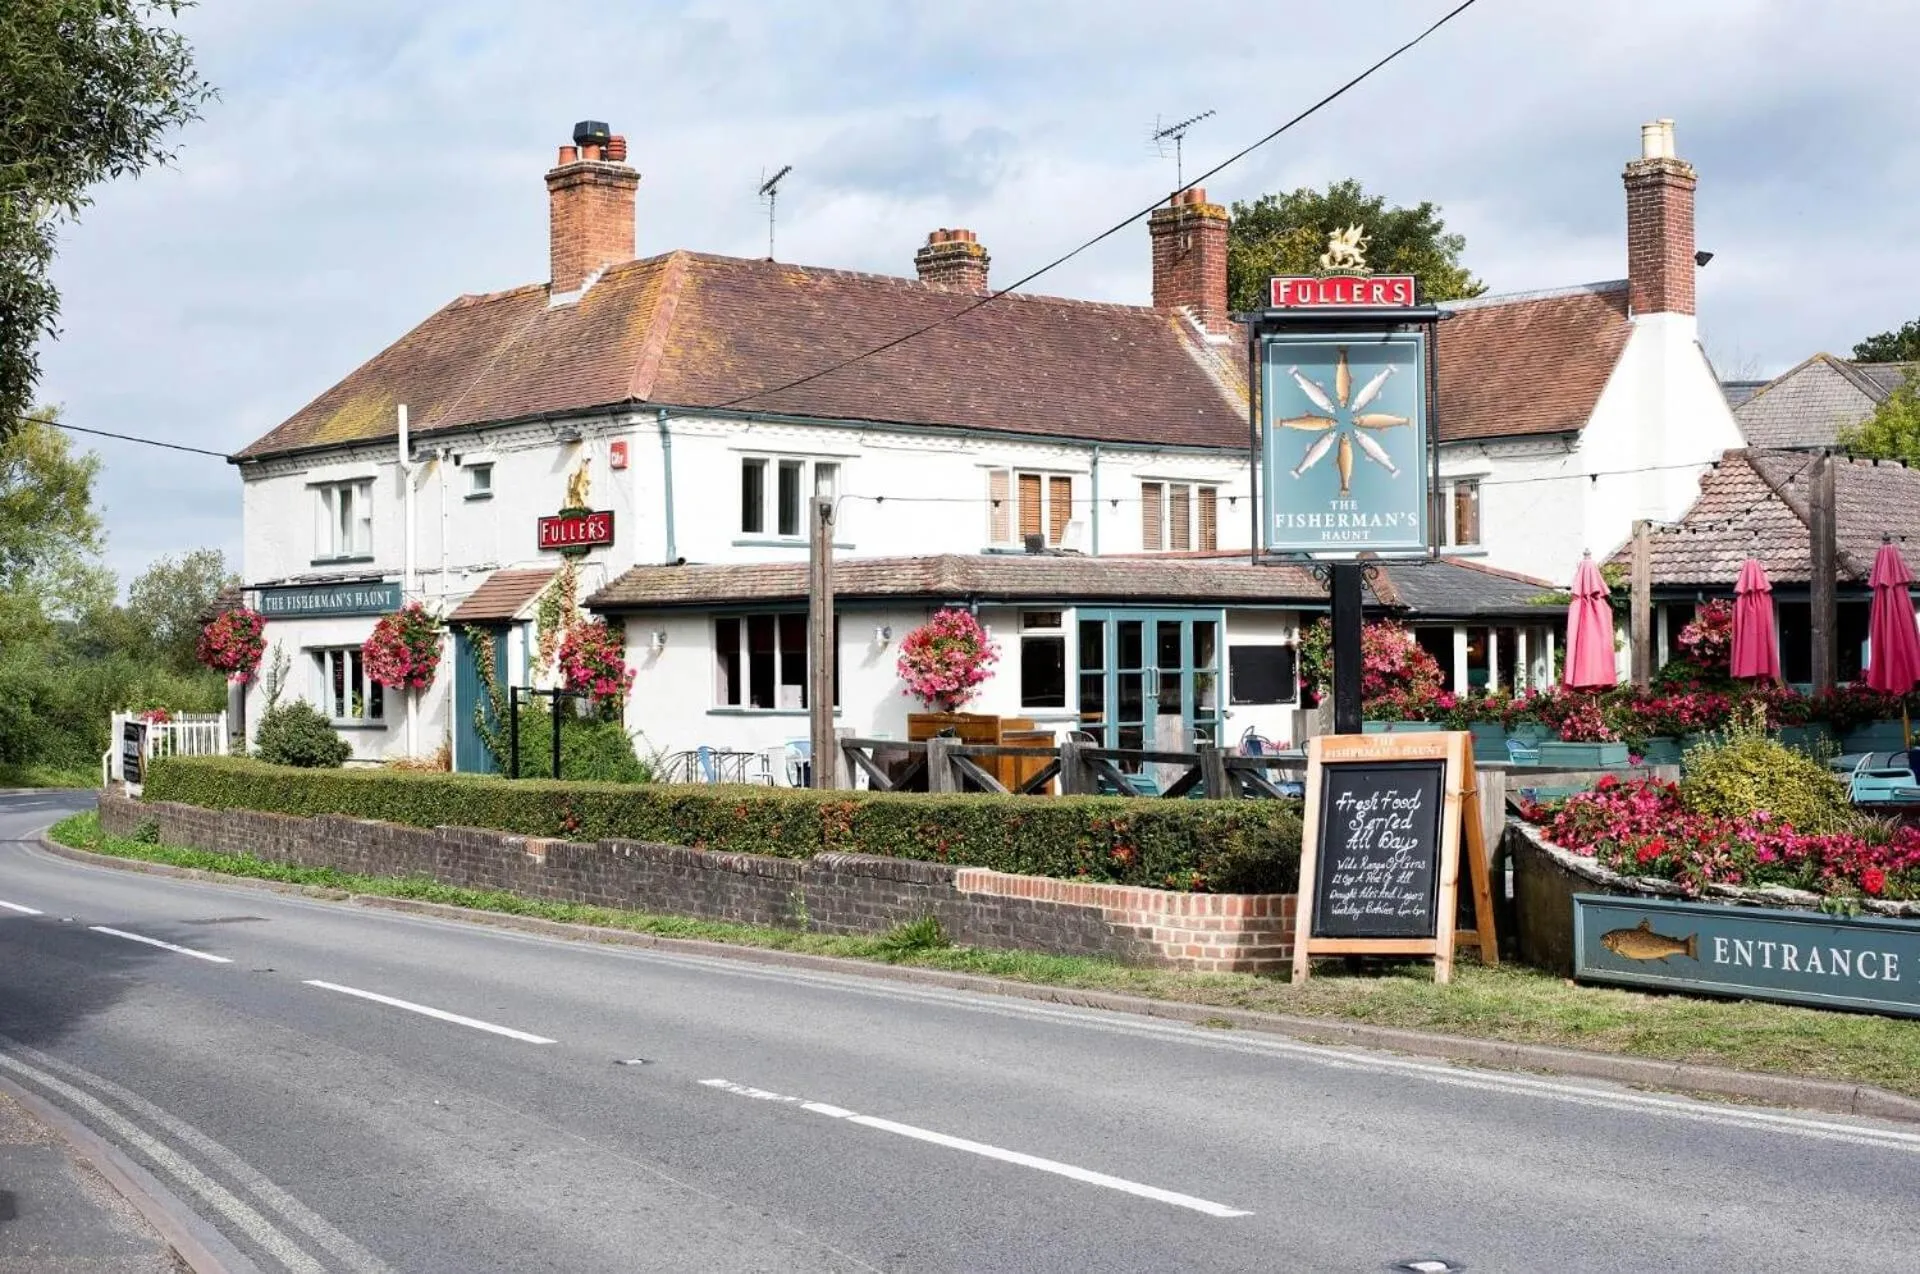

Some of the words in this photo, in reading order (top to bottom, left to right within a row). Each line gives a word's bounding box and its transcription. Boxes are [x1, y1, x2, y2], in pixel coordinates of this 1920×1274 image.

[1279, 280, 1406, 305] FULLER'S
[1330, 500, 1358, 511] THE
[542, 518, 606, 543] FULLER'S
[1275, 512, 1417, 529] FISHERMAN'S
[1321, 531, 1371, 541] HAUNT
[265, 597, 284, 611] THE
[287, 592, 351, 610] FISHERMAN'S
[355, 591, 392, 606] HAUNT
[1336, 791, 1380, 811] Fresh
[1381, 788, 1422, 810] Food
[1349, 809, 1414, 831] Served
[1346, 830, 1374, 850] All
[1378, 831, 1418, 862] Day
[1714, 937, 1901, 981] ENTRANCE
